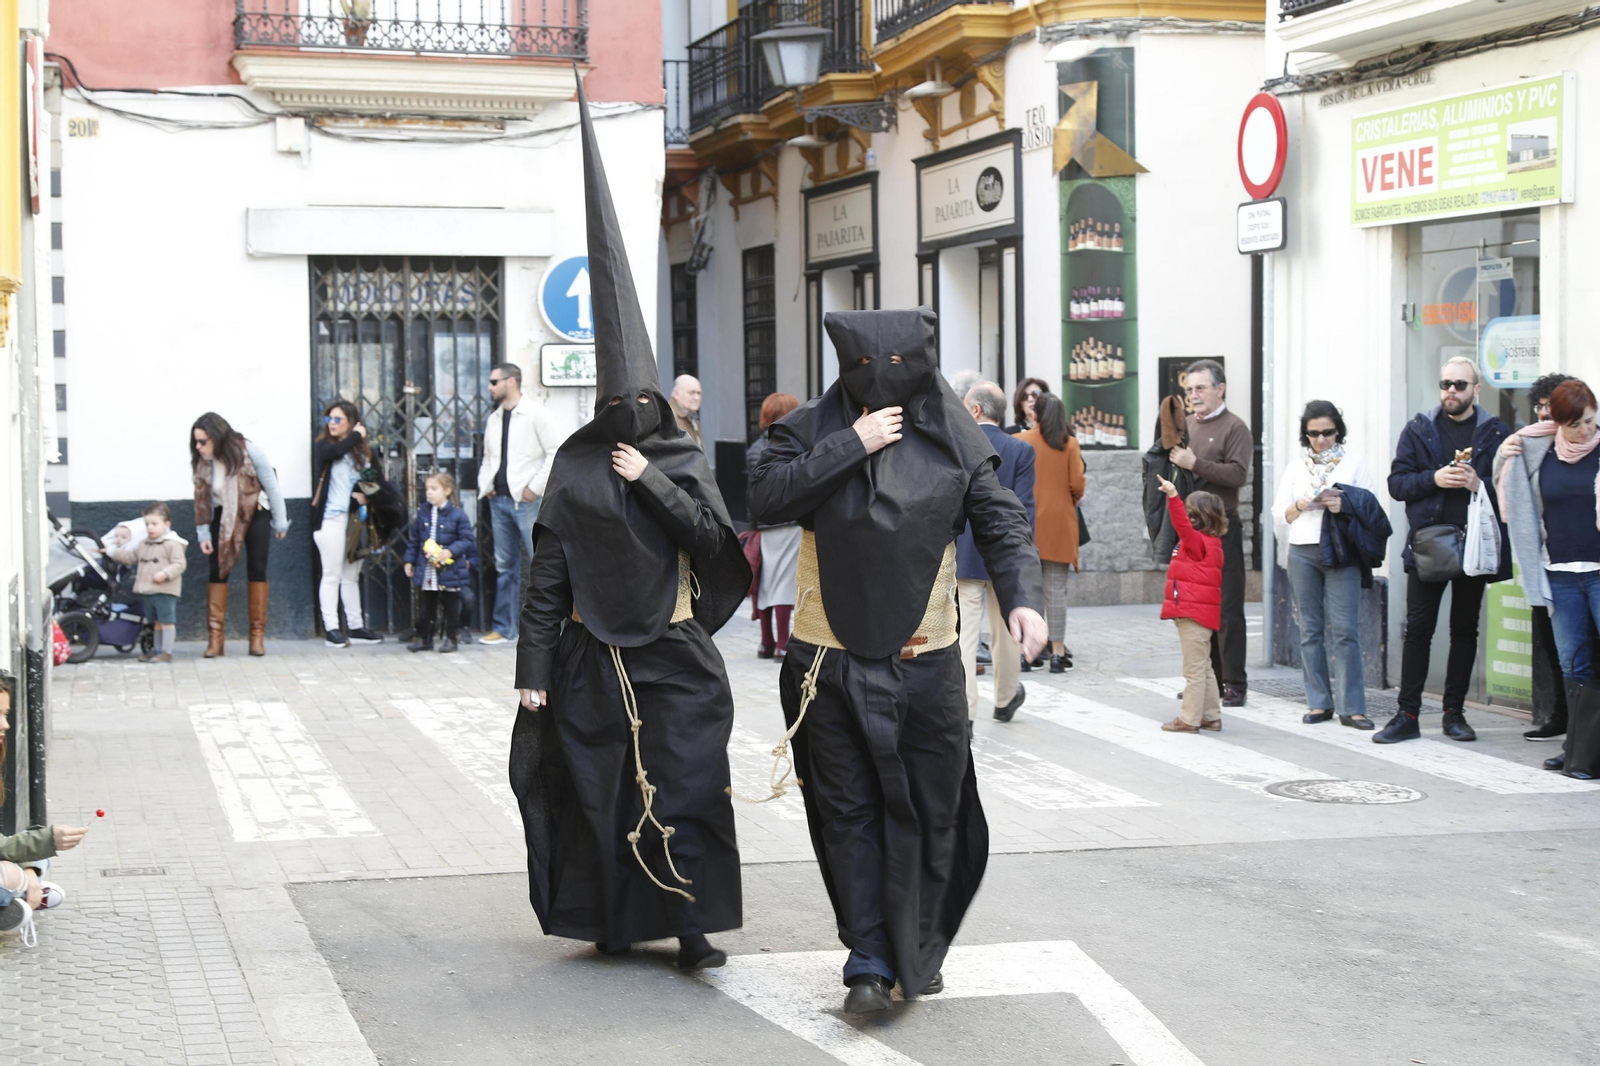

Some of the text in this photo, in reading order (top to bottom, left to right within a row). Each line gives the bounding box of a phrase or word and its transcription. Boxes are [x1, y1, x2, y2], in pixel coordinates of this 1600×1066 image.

[1348, 87, 1359, 101] DE
[1361, 84, 1373, 98] LA
[1376, 71, 1432, 93] VERA-CRUZ
[1026, 105, 1045, 128] TEO
[1355, 107, 1439, 143] CRISTALERIAS,
[1441, 92, 1513, 127] ALUMINIOS
[1517, 88, 1527, 112] Y
[1528, 82, 1558, 111] PVC
[1361, 145, 1434, 193] VENE
[948, 177, 960, 195] LA
[935, 199, 975, 223] PAJARITA
[1454, 192, 1479, 208] REALIDAD
[833, 204, 847, 222] LA
[817, 224, 866, 249] PAJARITA
